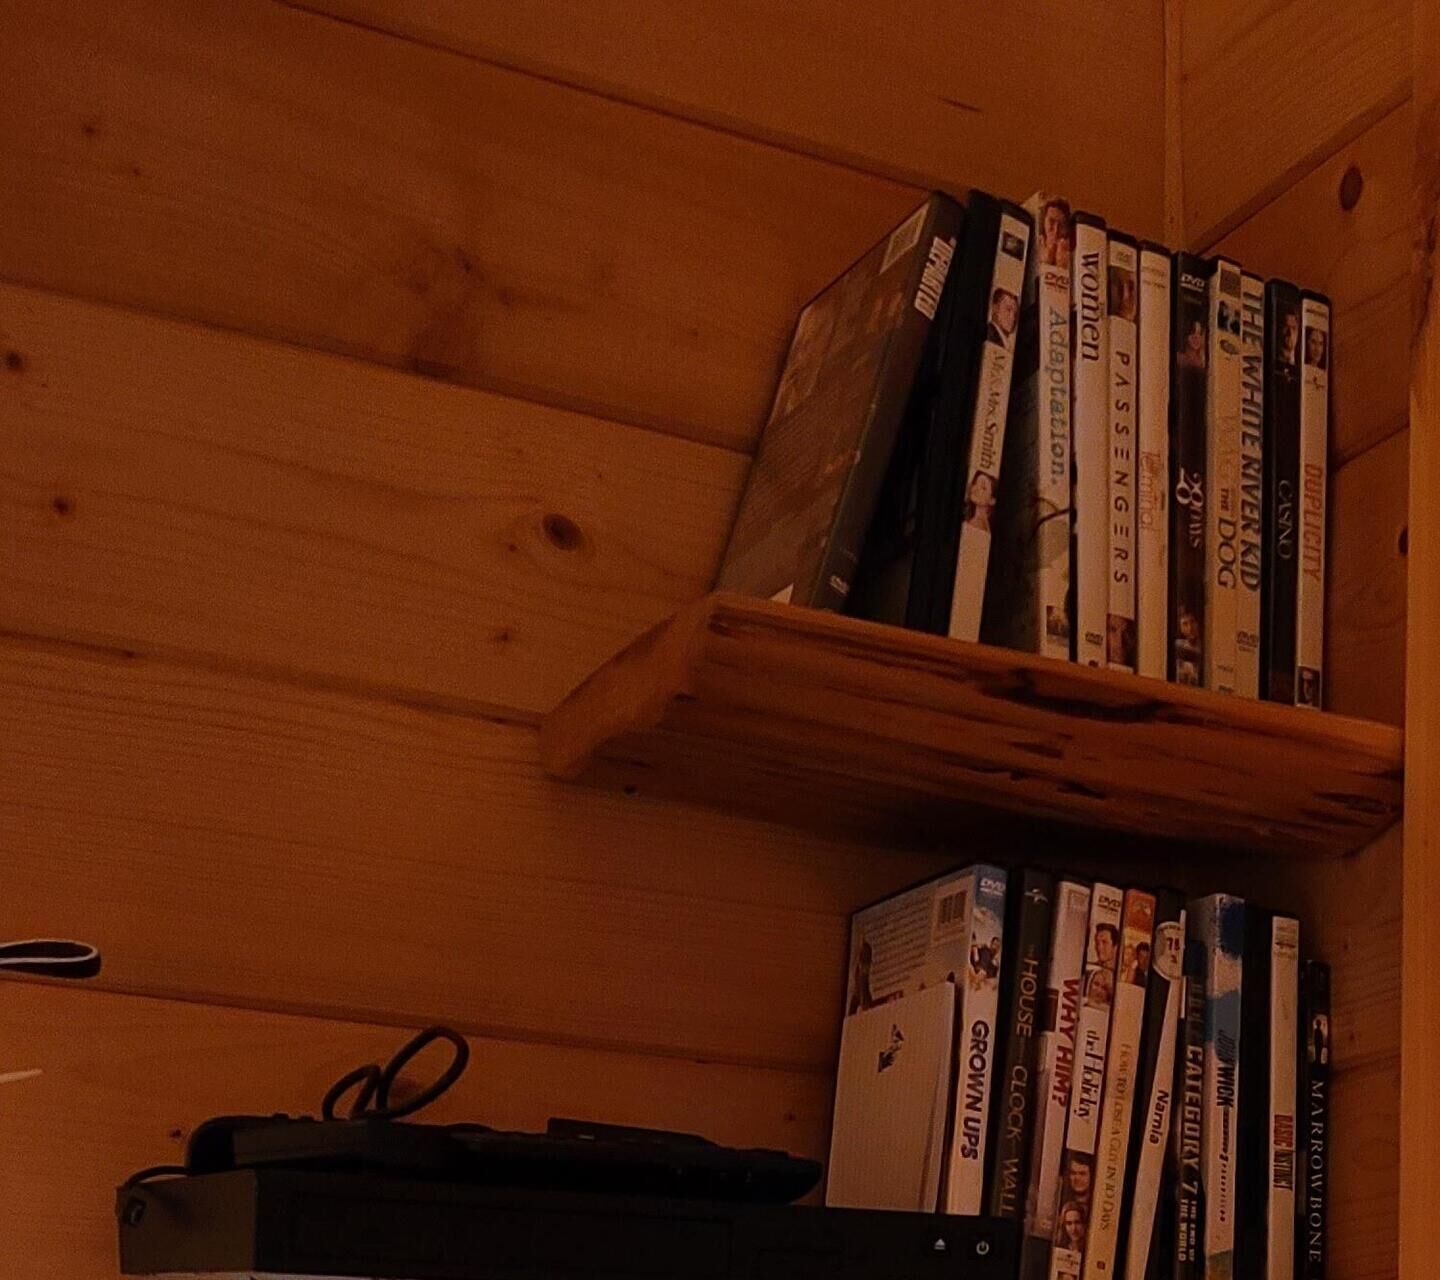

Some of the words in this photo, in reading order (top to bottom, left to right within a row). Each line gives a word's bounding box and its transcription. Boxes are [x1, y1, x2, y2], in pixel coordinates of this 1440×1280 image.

[1081, 252, 1100, 361] women
[1180, 271, 1205, 288] DVD
[1242, 291, 1262, 347] THE
[1047, 309, 1068, 485] Adaptation.
[1242, 355, 1262, 448] WHITE
[979, 420, 998, 470] Smith
[1114, 351, 1130, 583] PASSENGERS
[1175, 467, 1205, 507] 28
[1220, 488, 1229, 511] THE
[1241, 453, 1262, 532] RIVER
[1278, 479, 1294, 560] CASINO
[1303, 463, 1323, 581] DUPLICITY
[1217, 517, 1237, 590] DOG
[1240, 539, 1260, 592] KID
[979, 878, 1006, 893] DVD
[1016, 958, 1039, 1039] HOUSE
[1058, 979, 1080, 1043] WHY
[965, 1019, 990, 1112] GROWN
[1052, 1045, 1074, 1107] HIM?
[1074, 1050, 1104, 1121] Holiday
[1216, 1066, 1235, 1108] WICK
[1007, 1065, 1028, 1142] CLOCK
[1149, 1089, 1169, 1145] Narnia
[1182, 1044, 1204, 1172] CATEGORY
[1274, 1114, 1293, 1148] BASIC
[961, 1117, 982, 1160] UPS
[1182, 1181, 1199, 1196] 7
[1273, 1150, 1293, 1191] INSTINCT
[1309, 1079, 1324, 1263] MARROWBONE
[1178, 1222, 1188, 1262] WORLD
